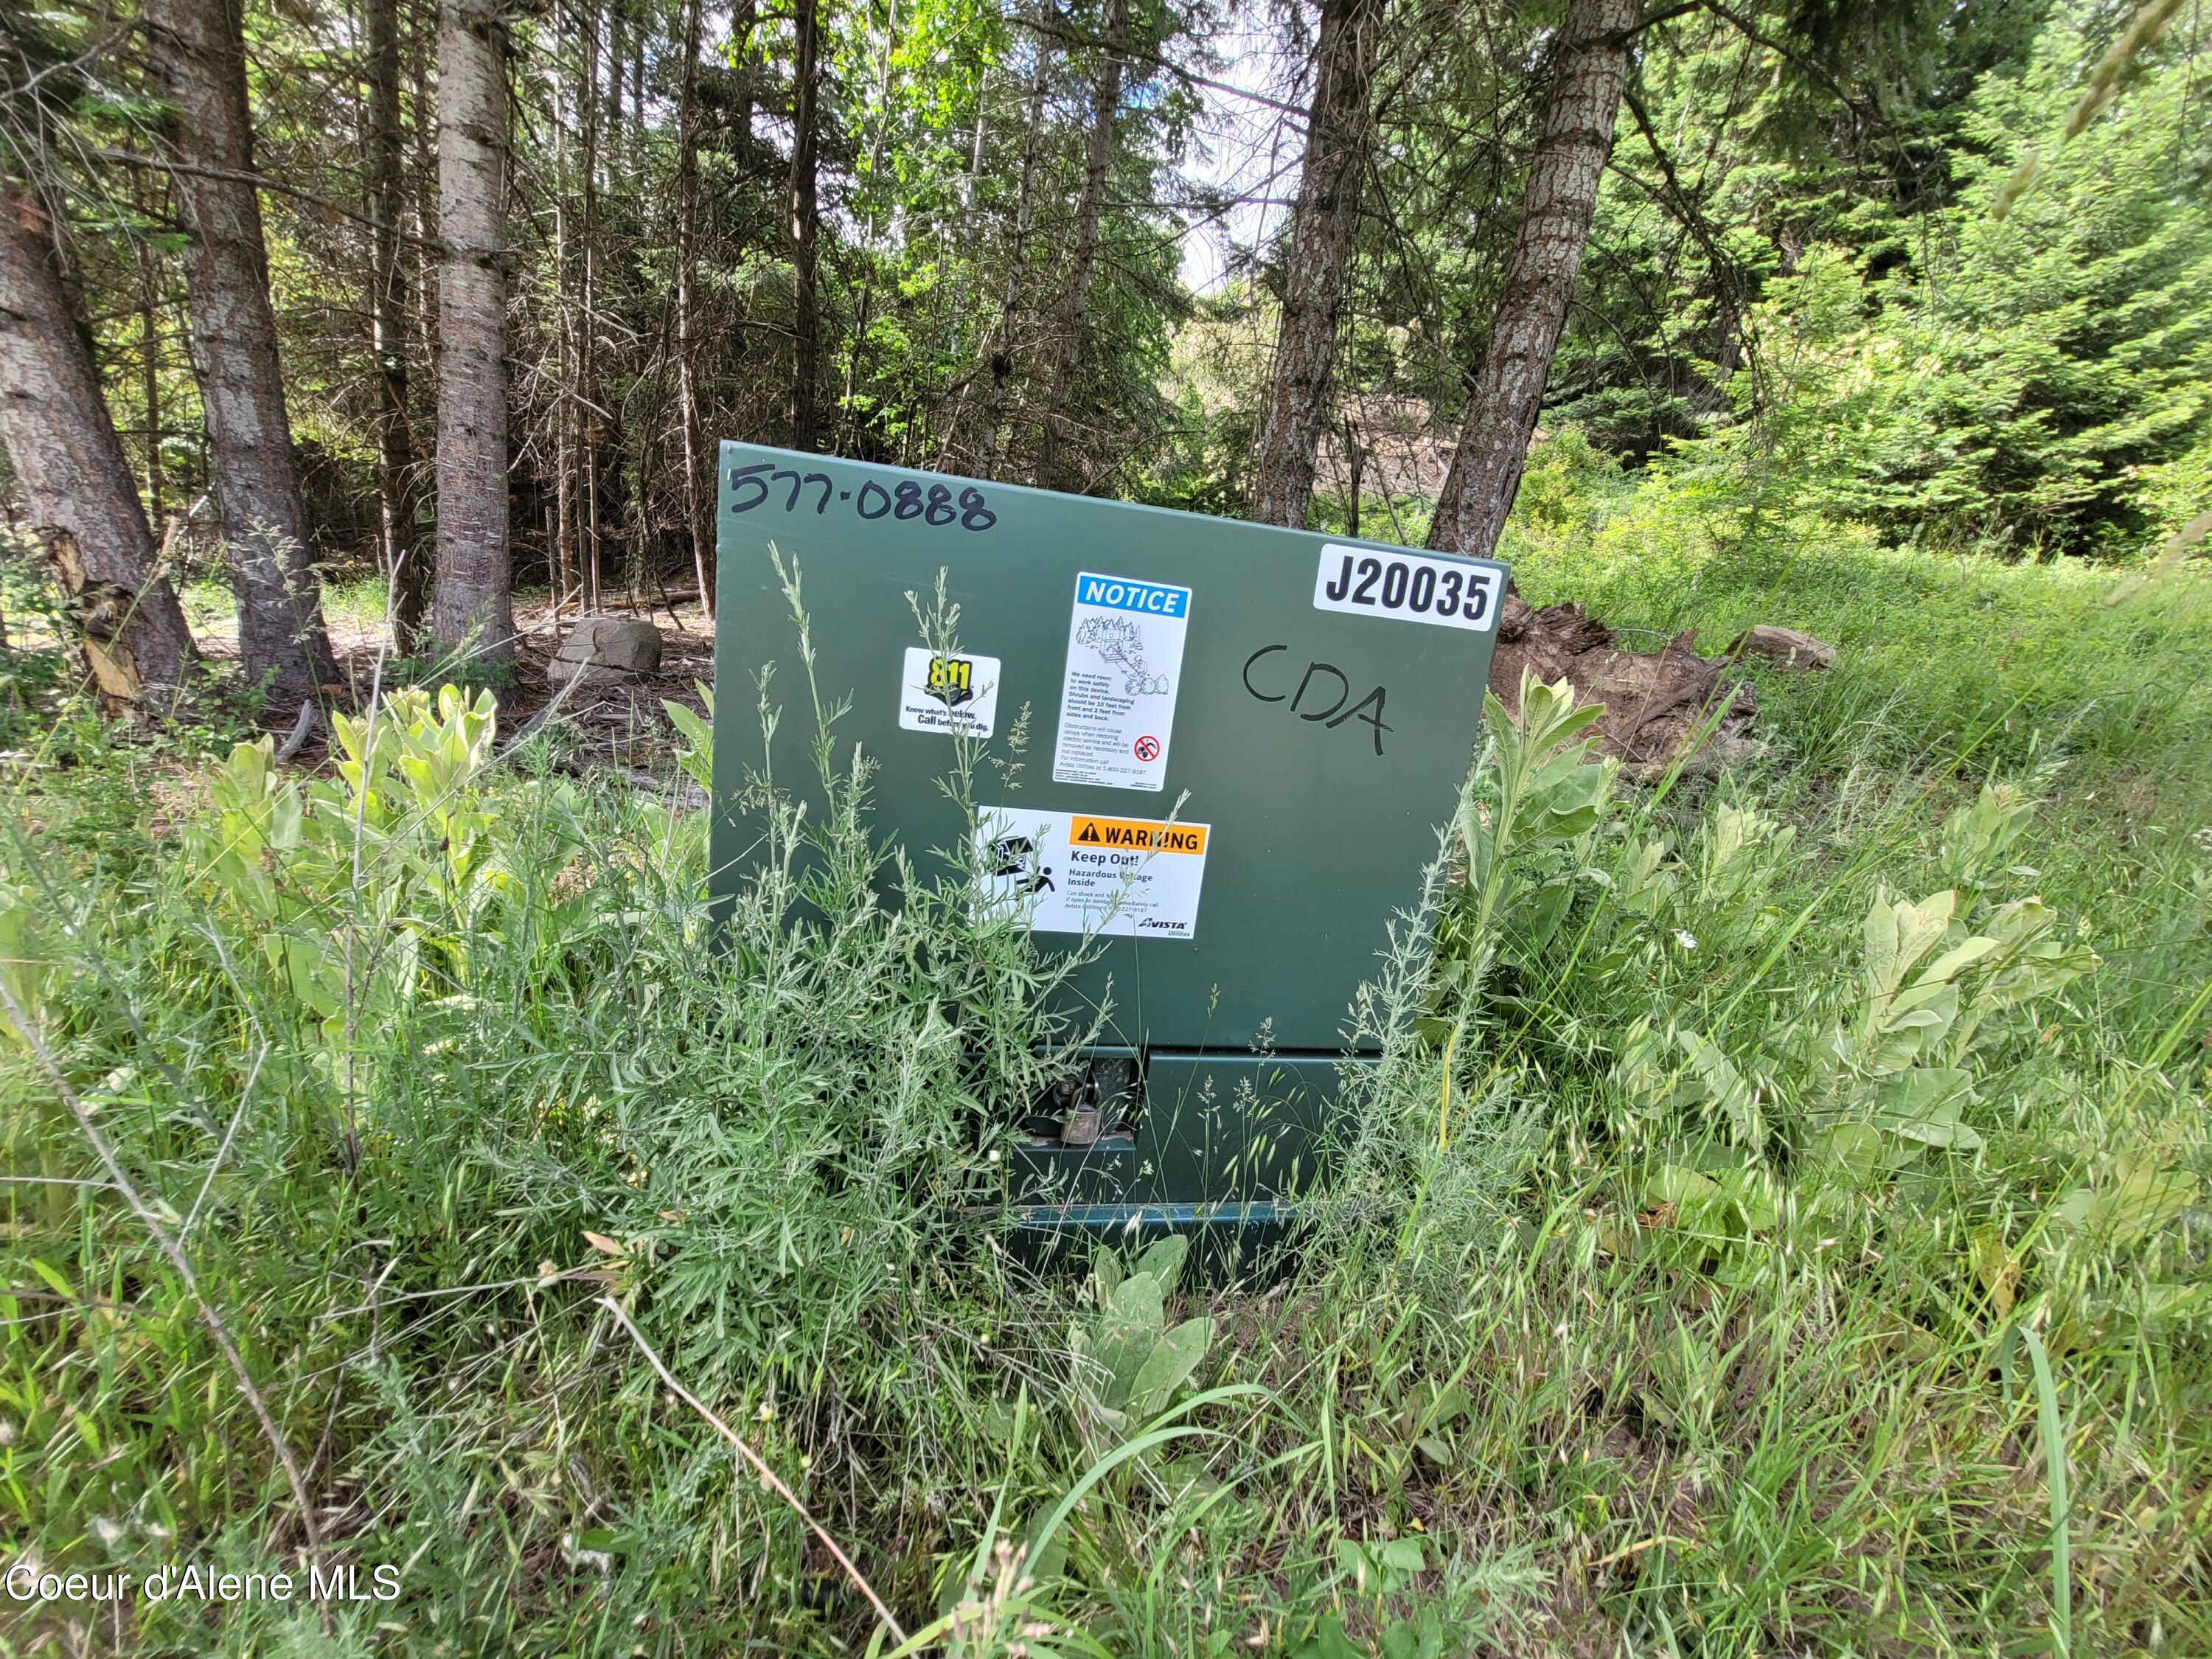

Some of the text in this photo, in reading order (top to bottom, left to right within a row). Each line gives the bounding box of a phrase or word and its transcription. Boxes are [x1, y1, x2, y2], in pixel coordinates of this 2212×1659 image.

[730, 463, 997, 532] 577-0888
[1326, 556, 1491, 621] J20035
[1085, 581, 1180, 613] NOTICE
[931, 660, 970, 690] 811
[1093, 681, 1110, 689] safely
[1102, 695, 1135, 705] landscaping
[1243, 644, 1394, 757] CDA
[905, 706, 925, 714] Know
[918, 714, 936, 725] Call
[976, 723, 989, 732] dig.
[1065, 723, 1096, 731] Obstructions
[1070, 756, 1099, 764] information
[1103, 765, 1148, 776] 1-800-227-9187.
[1105, 827, 1198, 850] WARNING
[1071, 850, 1139, 866] Keep Out!
[1069, 869, 1116, 879] Hazardous
[1068, 878, 1096, 887] Inside
